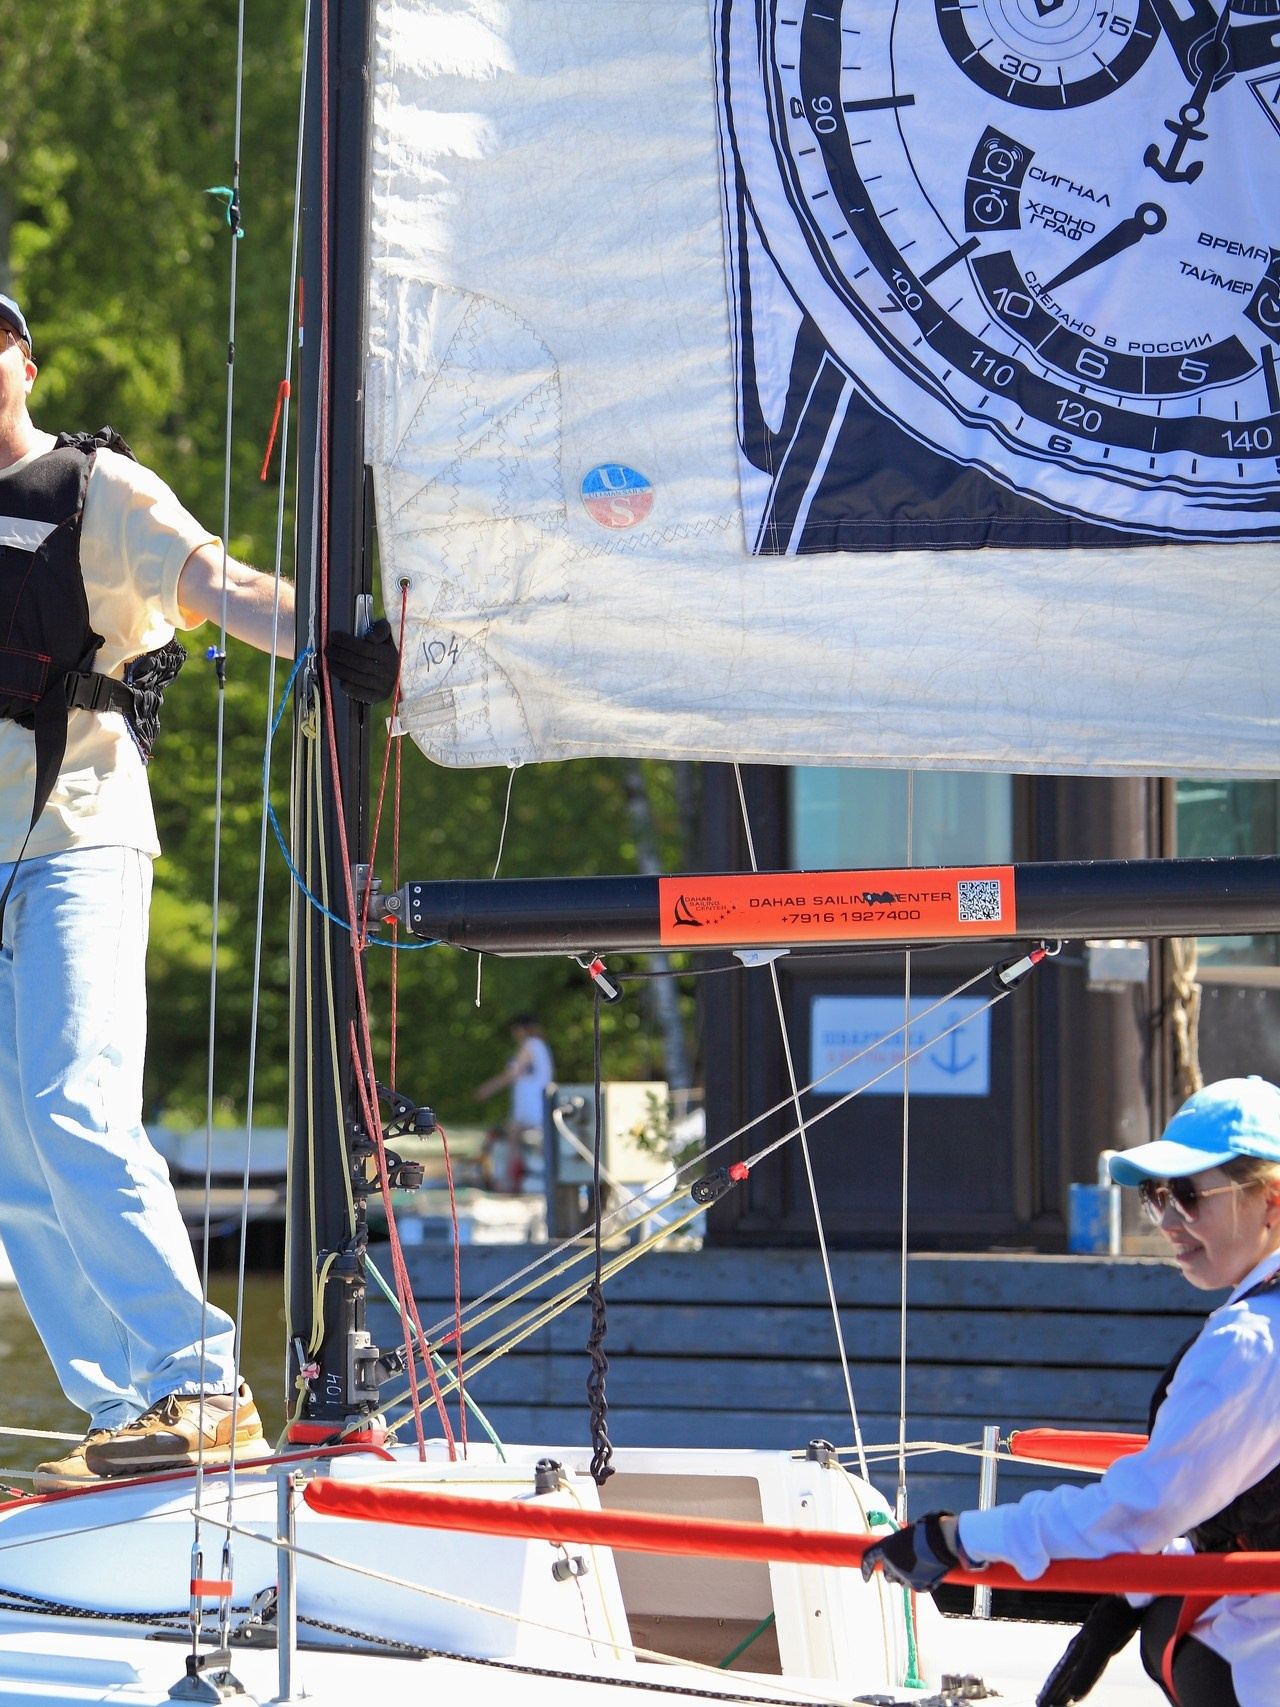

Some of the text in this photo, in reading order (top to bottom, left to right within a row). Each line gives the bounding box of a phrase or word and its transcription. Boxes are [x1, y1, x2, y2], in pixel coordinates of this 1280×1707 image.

[1096, 11, 1132, 37] 15
[999, 54, 1042, 83] 30
[811, 96, 837, 134] 90
[1028, 166, 1110, 207] СИГНАЛ
[1024, 199, 1096, 234] ХРОНО
[1029, 213, 1083, 241] ГРАФ
[1197, 232, 1269, 263] ВРЕМЯ
[892, 267, 923, 312] 100
[1179, 261, 1254, 295] ТАЙМЕР
[878, 293, 904, 313] 7
[992, 287, 1035, 319] 10
[1024, 271, 1213, 354] СДЕЛАНО В РОССИИ
[971, 351, 1015, 387] 110
[1075, 348, 1109, 380] 6
[1177, 358, 1210, 384] 5
[1056, 399, 1103, 433] 120
[1047, 434, 1072, 452] 6
[1221, 427, 1273, 452] 140
[598, 467, 627, 490] U
[610, 497, 635, 527] S
[422, 634, 459, 673] 104
[749, 891, 952, 908] DAHAB SAILIN ENTER
[781, 909, 921, 924] +7916 1927400
[325, 1372, 343, 1404] 104
